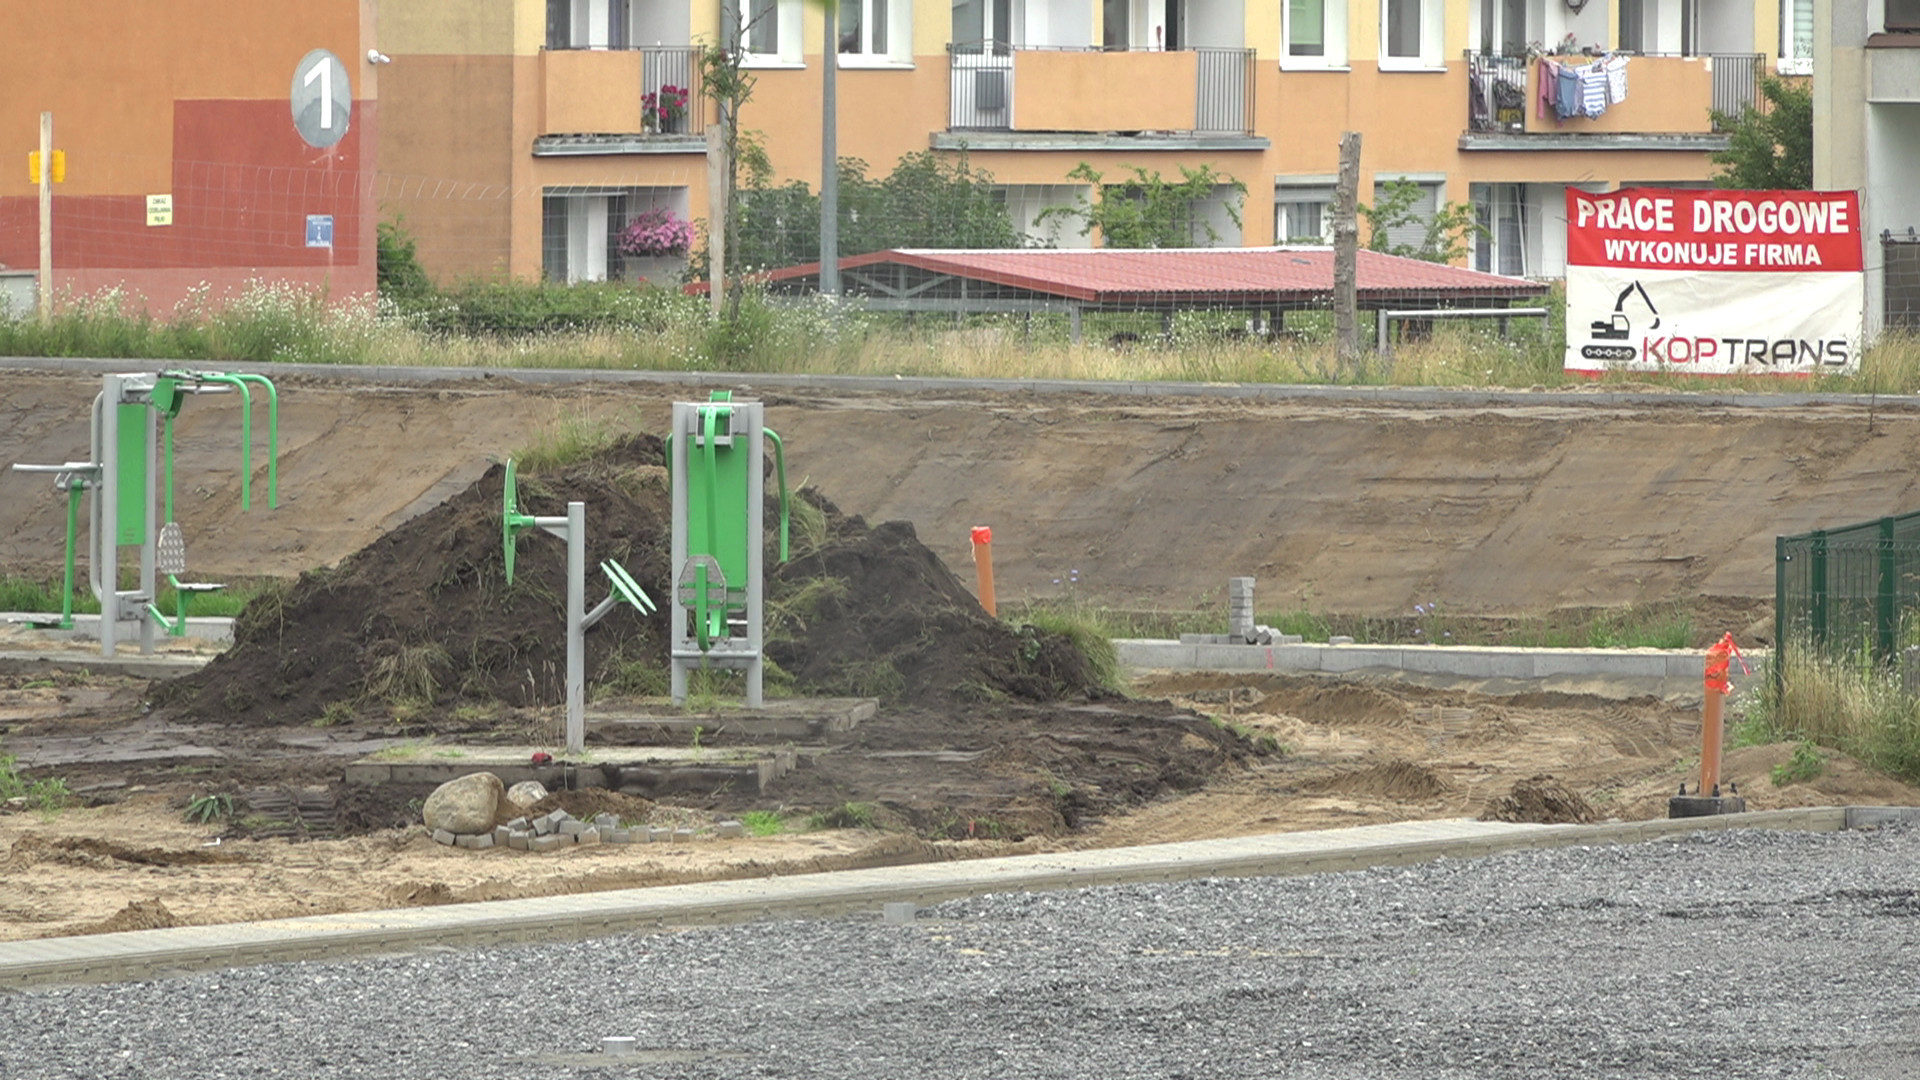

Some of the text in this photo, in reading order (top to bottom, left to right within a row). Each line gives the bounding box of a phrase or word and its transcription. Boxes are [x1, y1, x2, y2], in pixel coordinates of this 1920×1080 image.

[304, 57, 332, 129] 1
[1577, 197, 1849, 234] PRACE DROGOWE
[1605, 239, 1822, 265] WYKONUJE FIRMA
